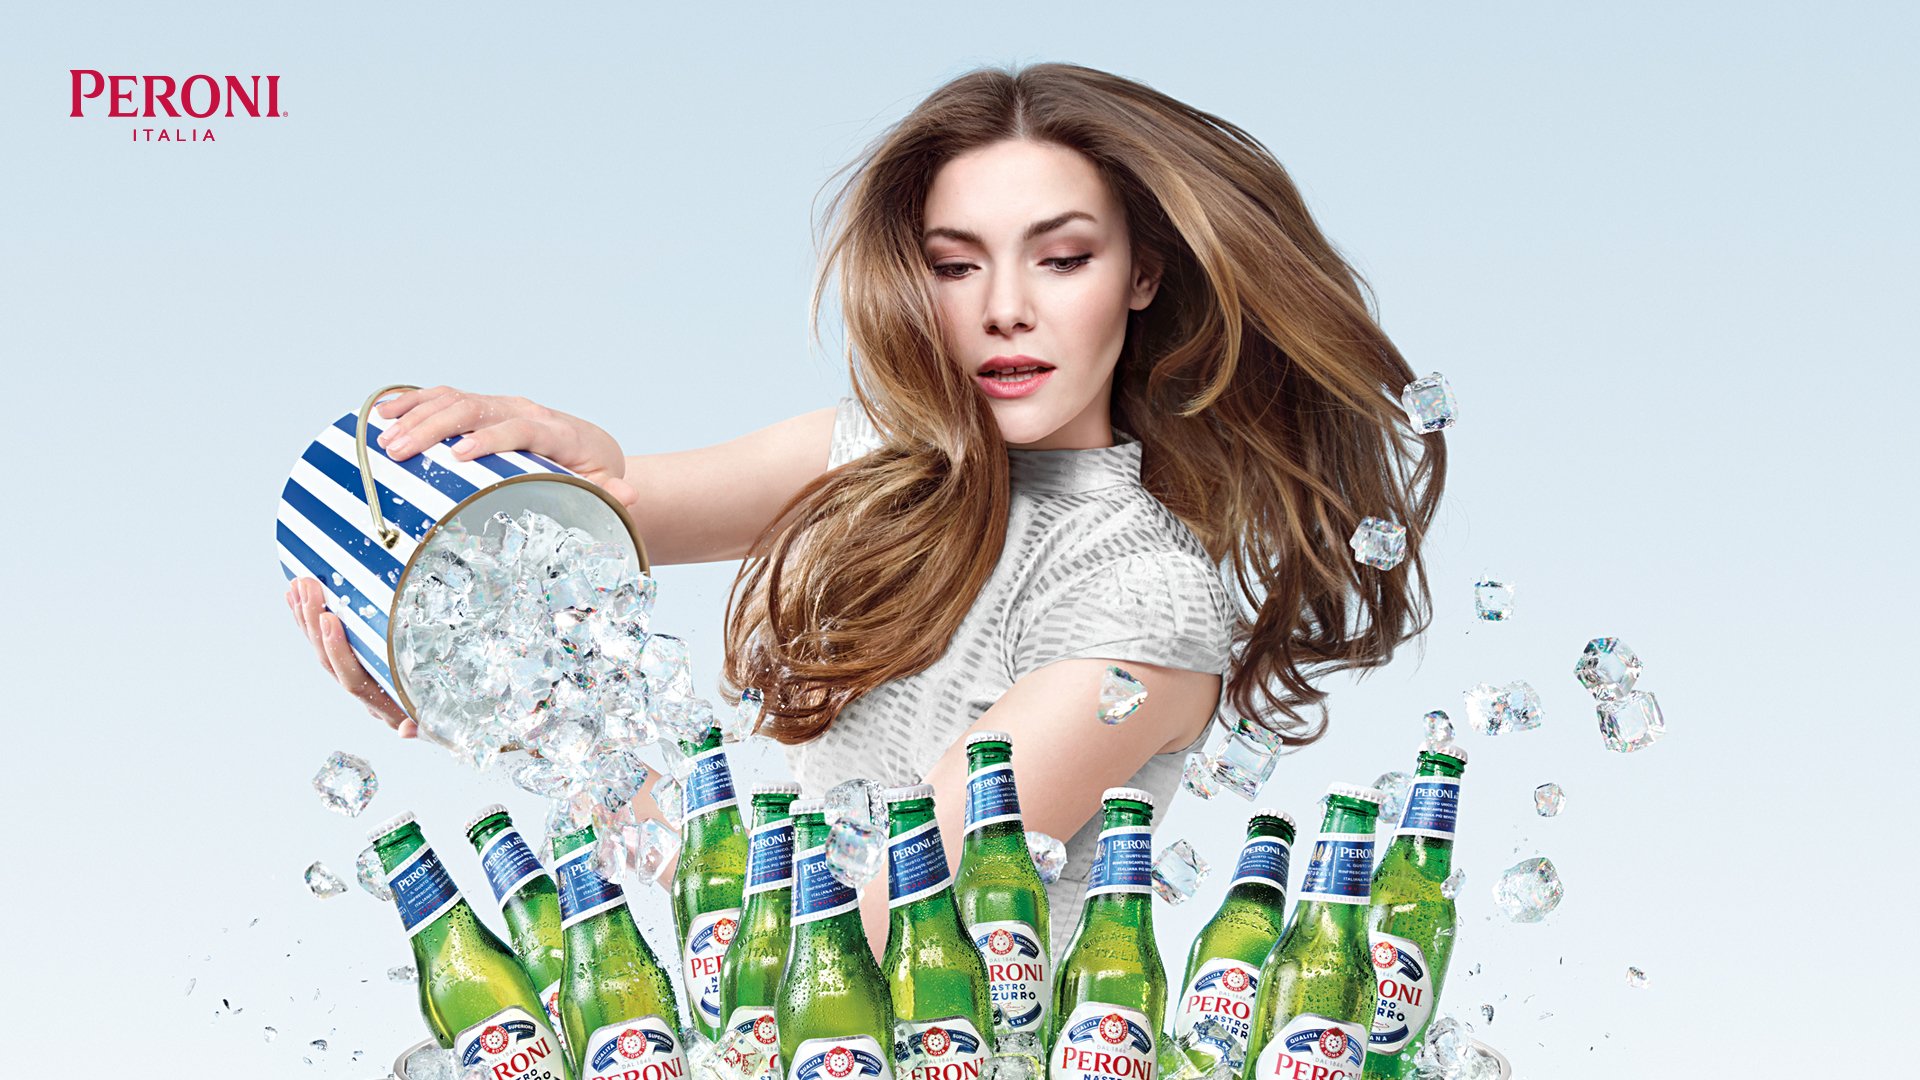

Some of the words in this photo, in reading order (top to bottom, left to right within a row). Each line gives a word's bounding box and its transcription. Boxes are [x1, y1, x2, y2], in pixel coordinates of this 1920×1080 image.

[693, 758, 725, 777] PERONI
[972, 775, 1008, 792] PERONI
[1414, 787, 1453, 799] PERONI
[754, 833, 786, 851] ERONI
[893, 838, 931, 861] PERONI
[1113, 839, 1150, 850] PERONI
[484, 841, 514, 872] PERONI
[1243, 845, 1280, 857] PERONI
[1340, 846, 1374, 859] PERON
[397, 859, 434, 891] PERONI
[803, 860, 828, 875] PER
[989, 963, 1043, 982] RONI
[991, 983, 1026, 991] ASTRO
[1379, 979, 1423, 1007] ONI
[991, 991, 1036, 1001] ZURRO
[1186, 995, 1250, 1020] PERO
[507, 1022, 534, 1031] SUPERIORE
[1072, 1020, 1098, 1036] QUALITÀ
[1204, 1014, 1249, 1030] NASTRO
[952, 1033, 978, 1047] SUPERIORE
[1104, 1035, 1121, 1043] ROMA
[1289, 1031, 1319, 1044] QUALITÀ
[594, 1042, 616, 1065] QUALITÀ
[647, 1032, 673, 1046] SUPERIORE
[1323, 1049, 1340, 1058] ROMA
[492, 1036, 552, 1080] RONI
[621, 1061, 634, 1070] DAL
[800, 1056, 823, 1074] QUALITÀ
[1062, 1046, 1152, 1080] PERONI
[1315, 1056, 1328, 1065] DAL
[592, 1056, 684, 1080] RONI
[832, 1069, 850, 1078] ROMA
[910, 1056, 985, 1080] ERON
